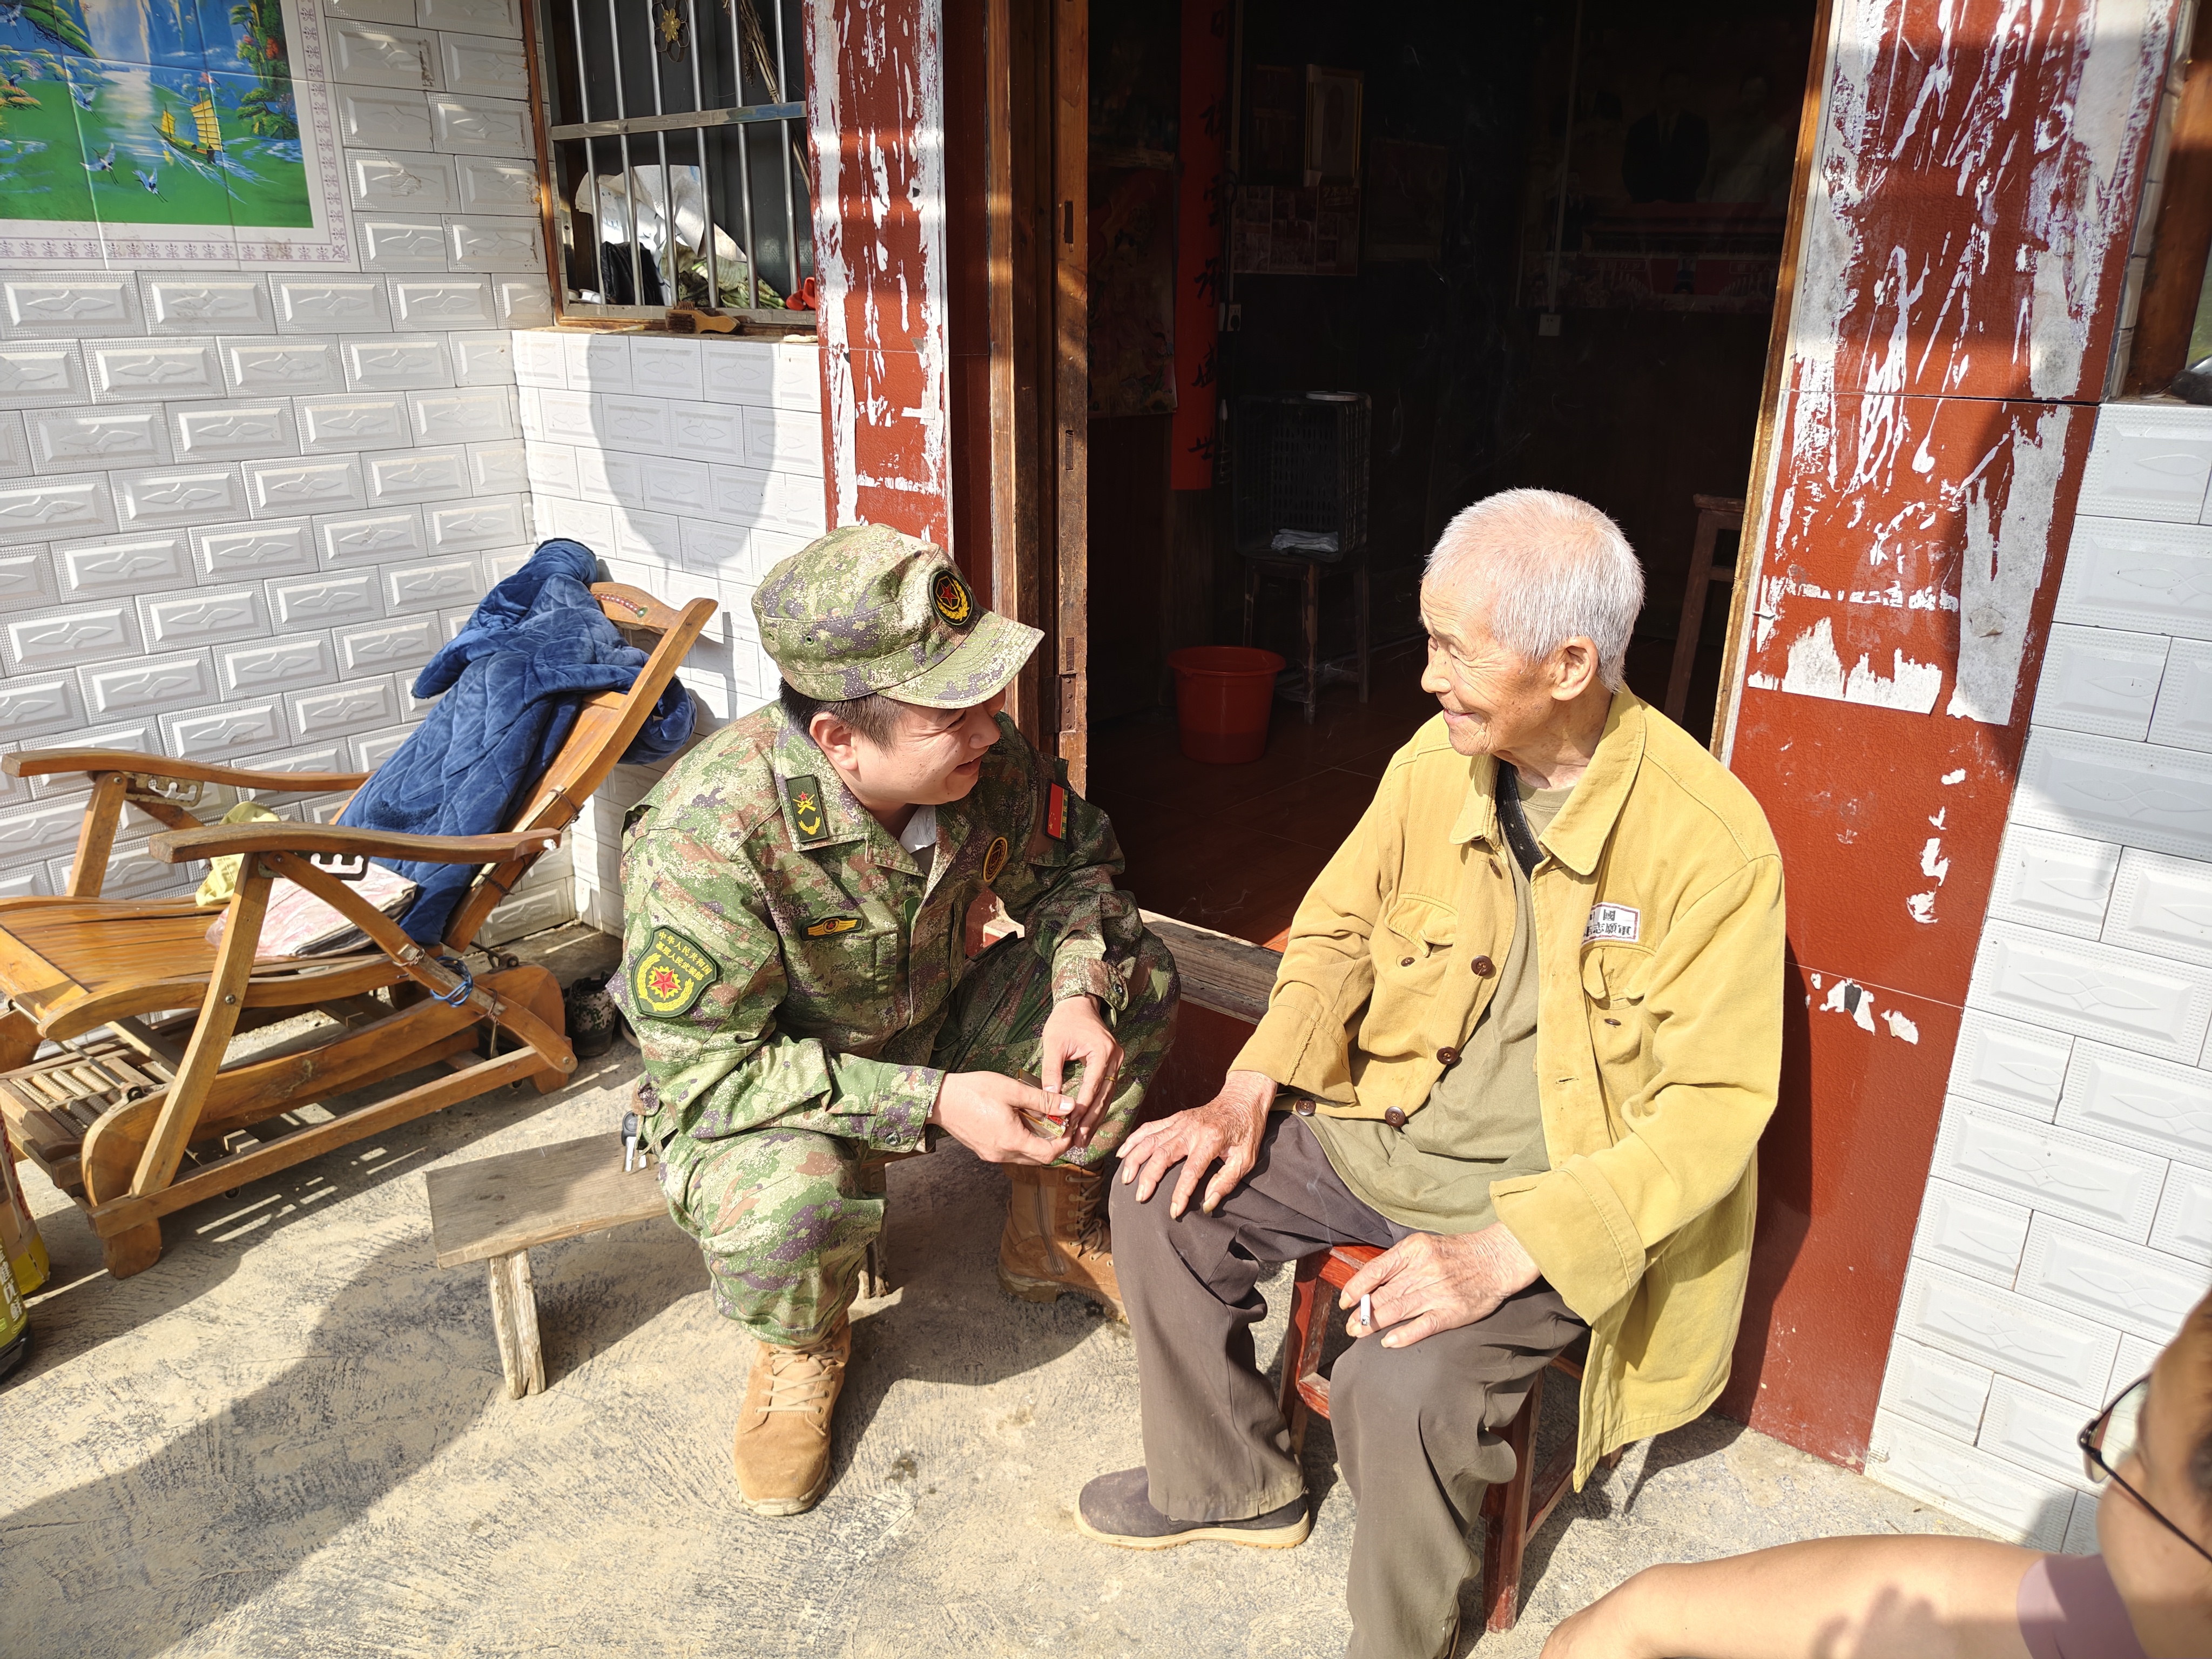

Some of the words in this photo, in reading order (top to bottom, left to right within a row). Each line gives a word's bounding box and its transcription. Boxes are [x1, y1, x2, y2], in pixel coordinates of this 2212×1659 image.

[656, 941, 704, 981] 基层人民武装部
[658, 930, 712, 975] 中华人民共和国
